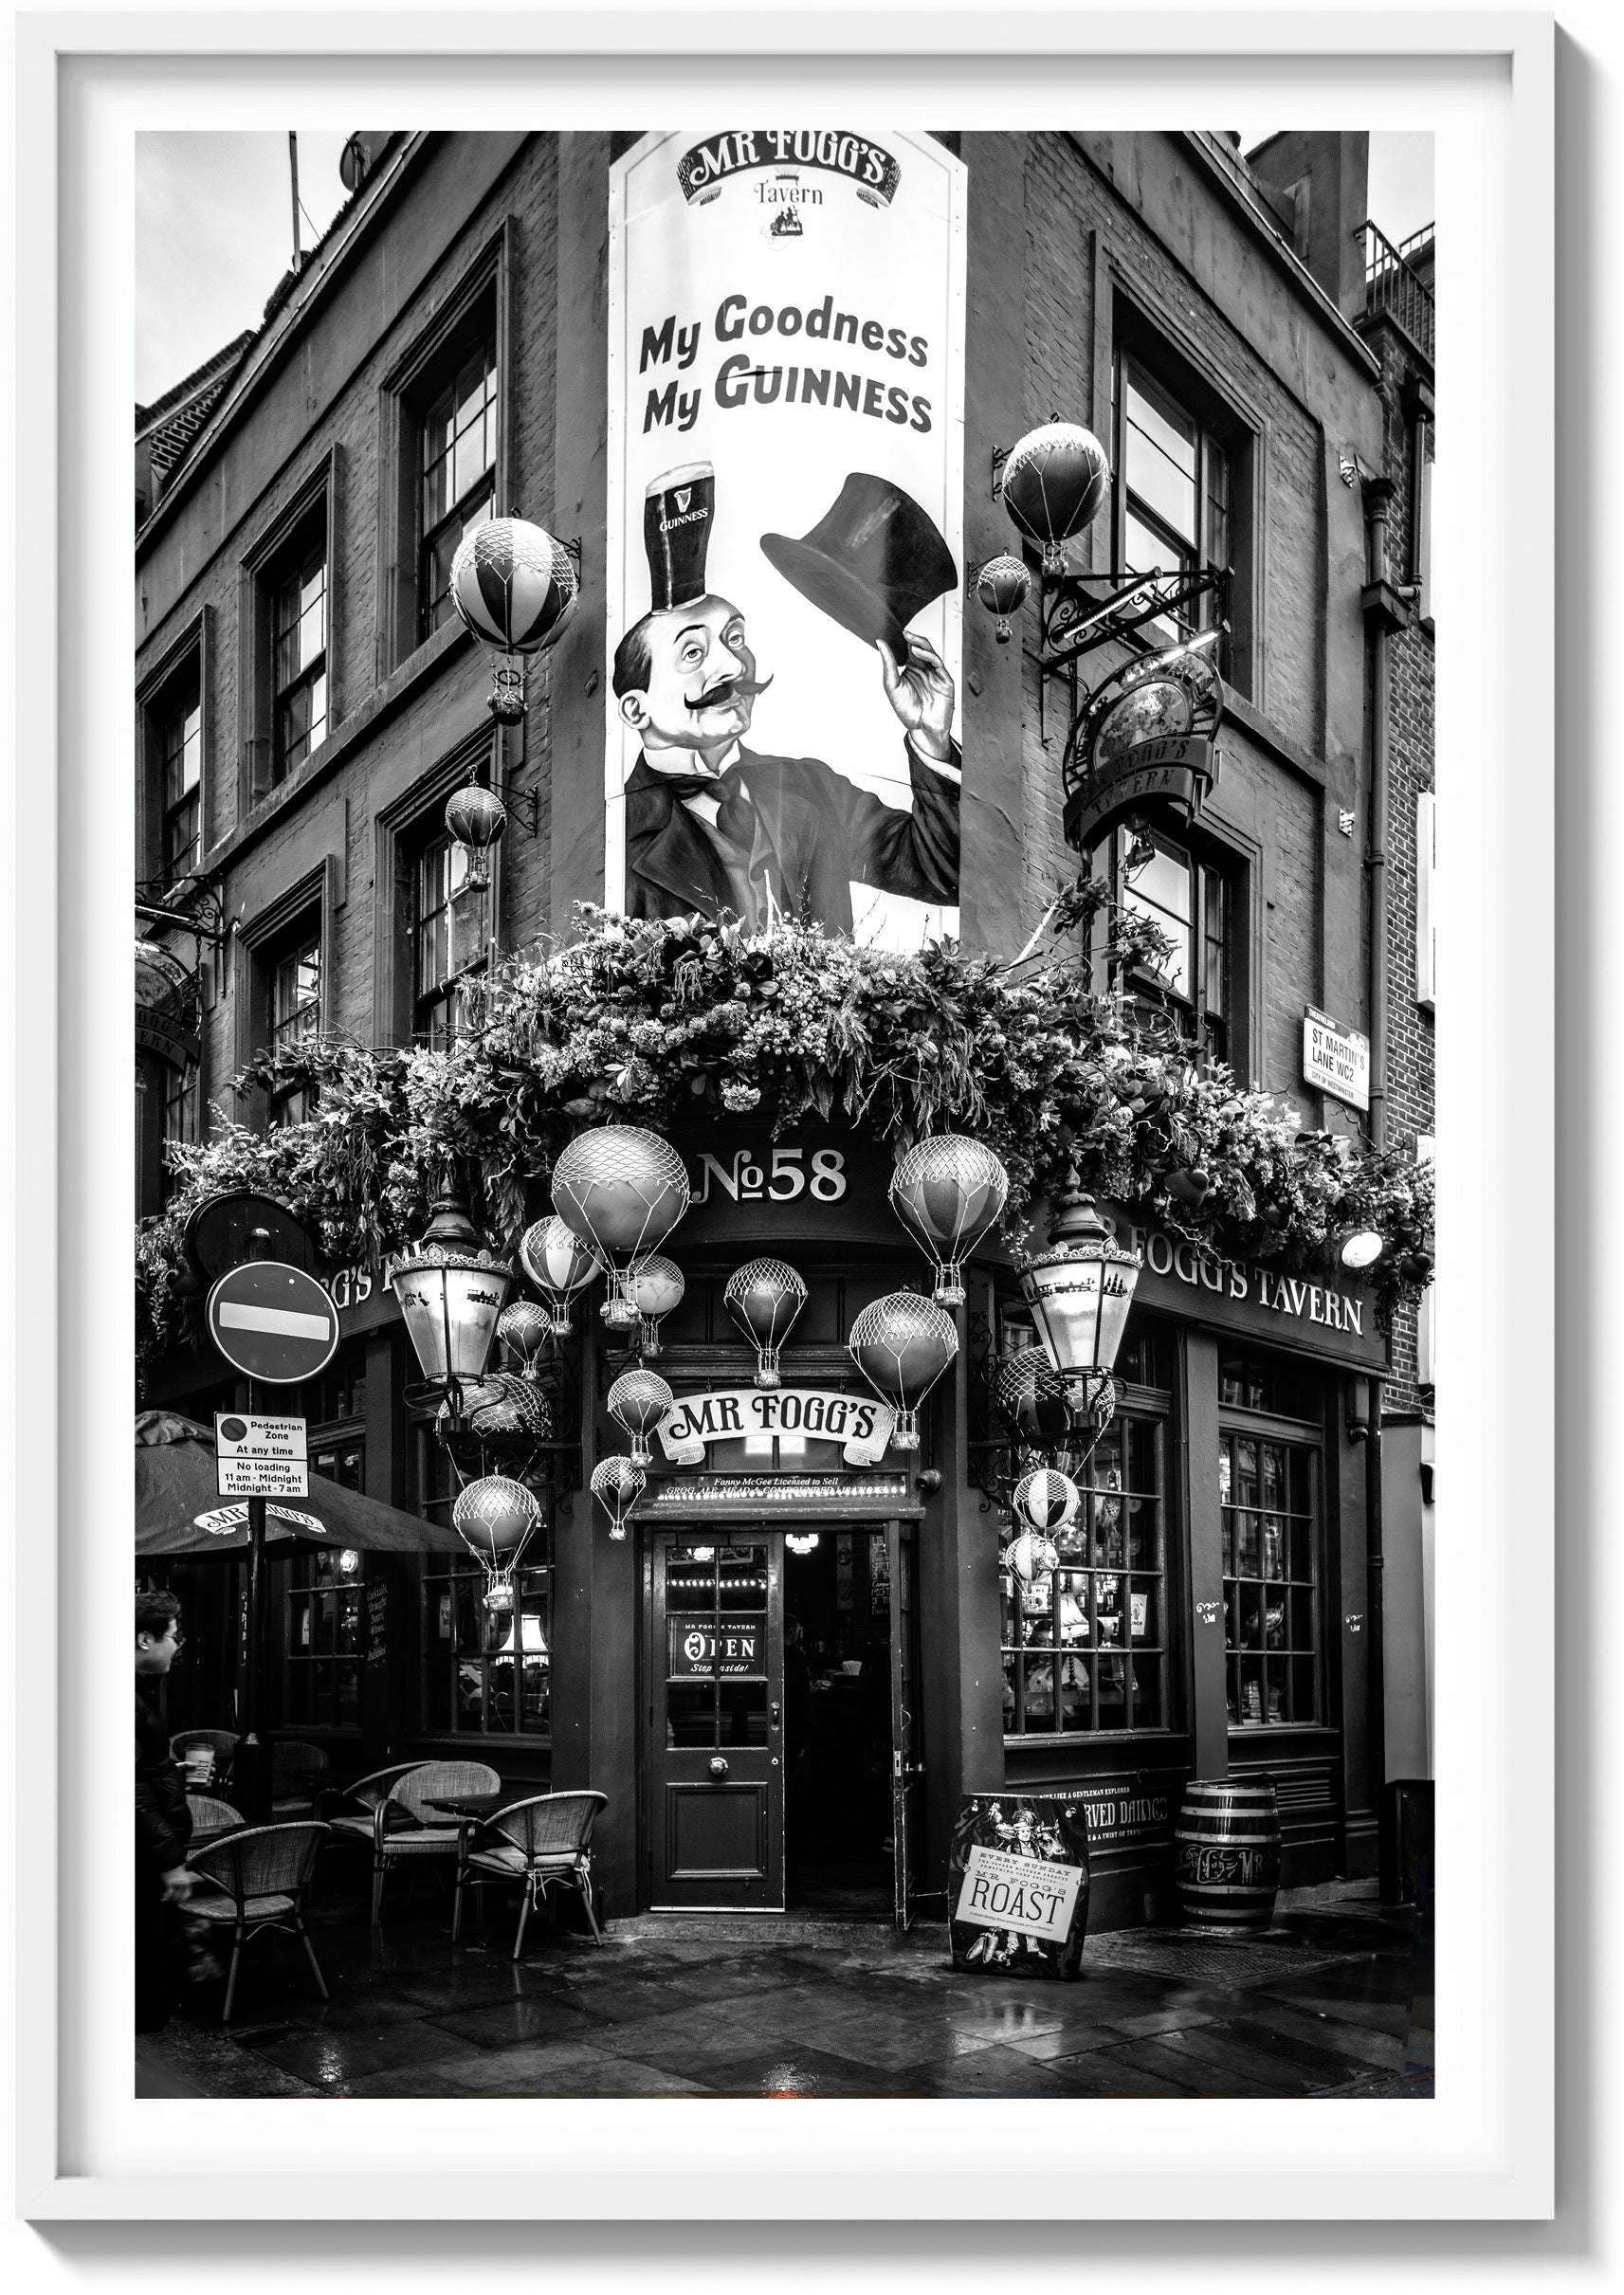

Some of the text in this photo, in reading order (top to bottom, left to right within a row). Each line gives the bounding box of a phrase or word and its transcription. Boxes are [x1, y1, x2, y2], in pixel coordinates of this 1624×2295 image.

[689, 131, 886, 186] MR FOGG'S
[754, 179, 824, 205] Tavern
[639, 294, 928, 374] My Goodness
[643, 354, 932, 434] My GUINNESS
[659, 507, 708, 532] GUINNESS
[1312, 1029, 1365, 1070] ST MARTIN'S
[1312, 1047, 1355, 1083] LANE WC2
[1129, 1224, 1248, 1299] FOGG'S
[1254, 1267, 1363, 1336] TAVERN
[250, 1421, 303, 1431] Pedestrian
[668, 1393, 878, 1440] MR FOGG'S
[265, 1431, 289, 1440] Zone
[236, 1445, 294, 1456] At any time
[237, 1462, 291, 1473] No loading
[259, 1473, 302, 1484] Midnight
[228, 1483, 272, 1493] Midnight
[714, 1477, 839, 1487] Fanny McGee Licensed to Sell
[206, 1507, 249, 1528] MR
[690, 1664, 713, 1673] Step
[1072, 1789, 1104, 1798] GENTLEMAN
[1104, 1786, 1130, 1795] EXPLORER
[1083, 1802, 1116, 1828] RVED
[1102, 1831, 1118, 1839] TWIST
[978, 1851, 1071, 1877] EVERY SUNDAY
[975, 1869, 1067, 1895] MR FOGG'S
[968, 1877, 1065, 1924] ROAST
